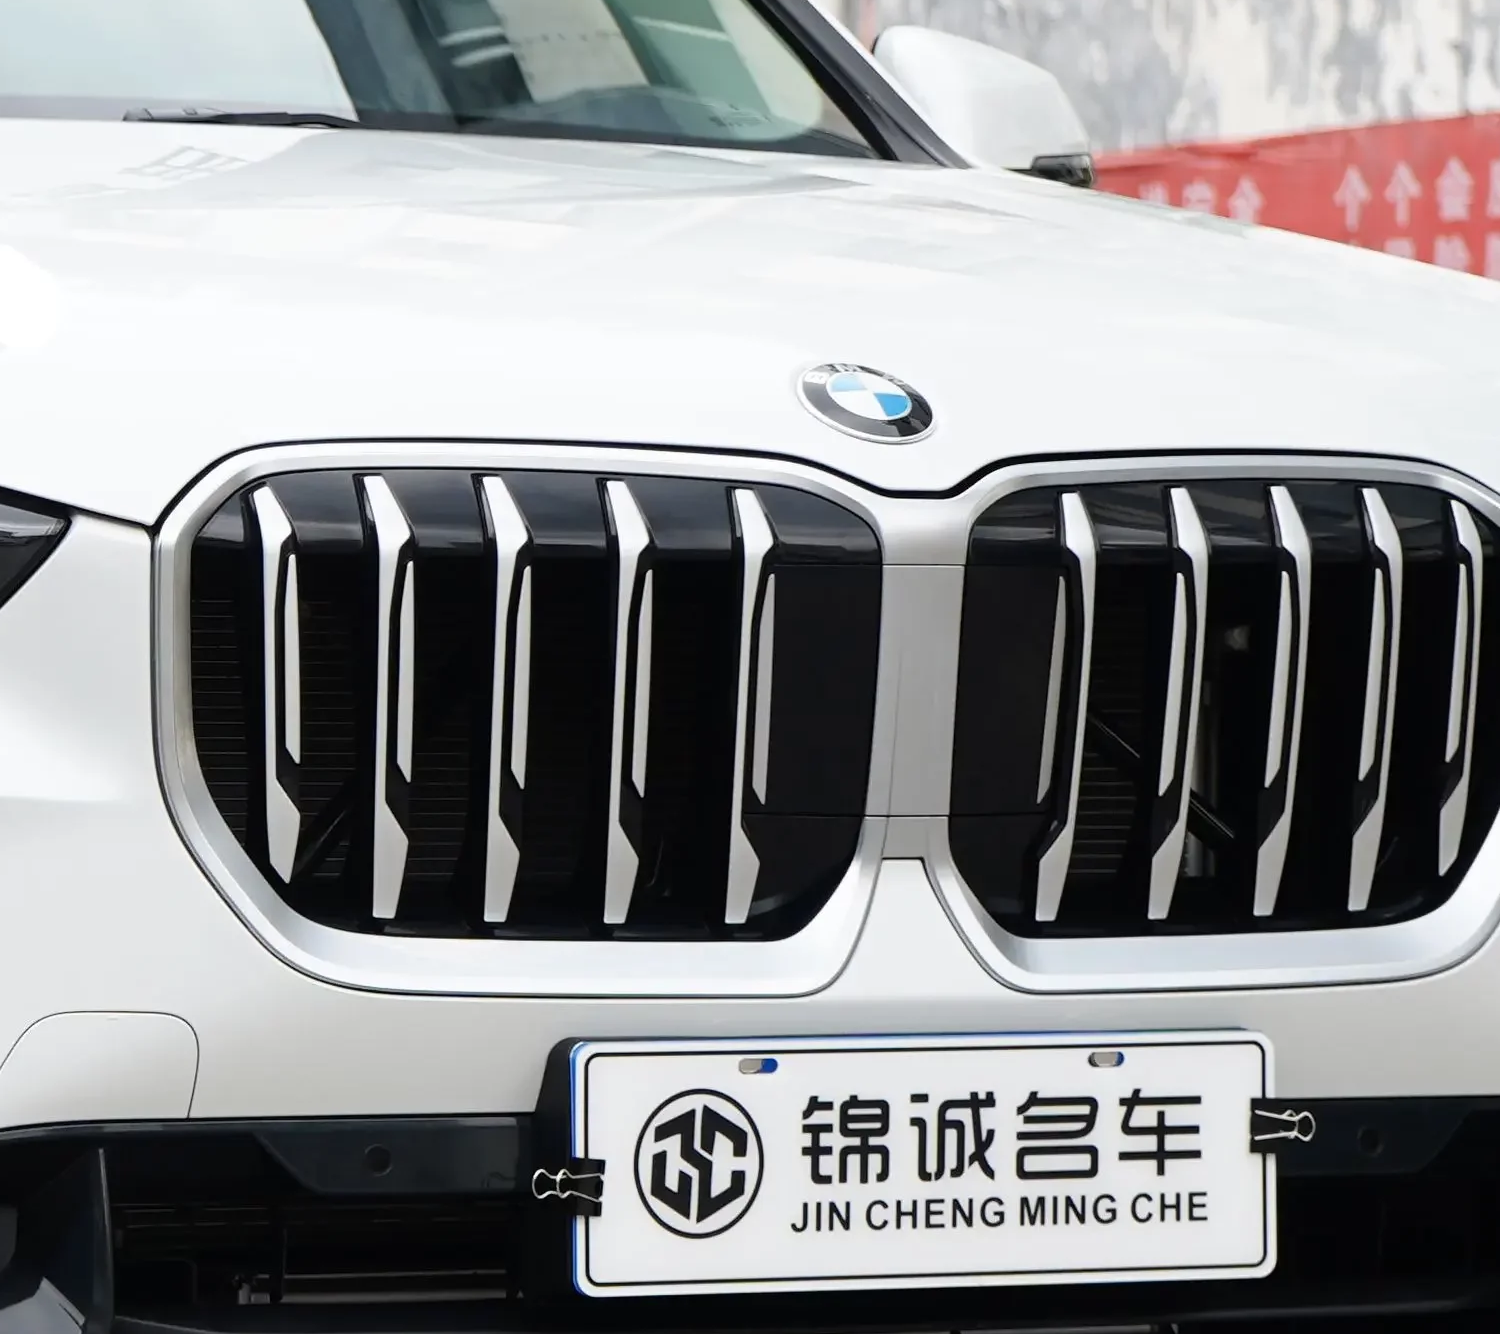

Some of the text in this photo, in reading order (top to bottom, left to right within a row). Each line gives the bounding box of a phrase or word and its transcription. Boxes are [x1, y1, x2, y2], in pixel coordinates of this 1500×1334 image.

[801, 1088, 1202, 1185] 锦诚名车
[790, 1191, 1208, 1233] JIN CHENG MING CHE
